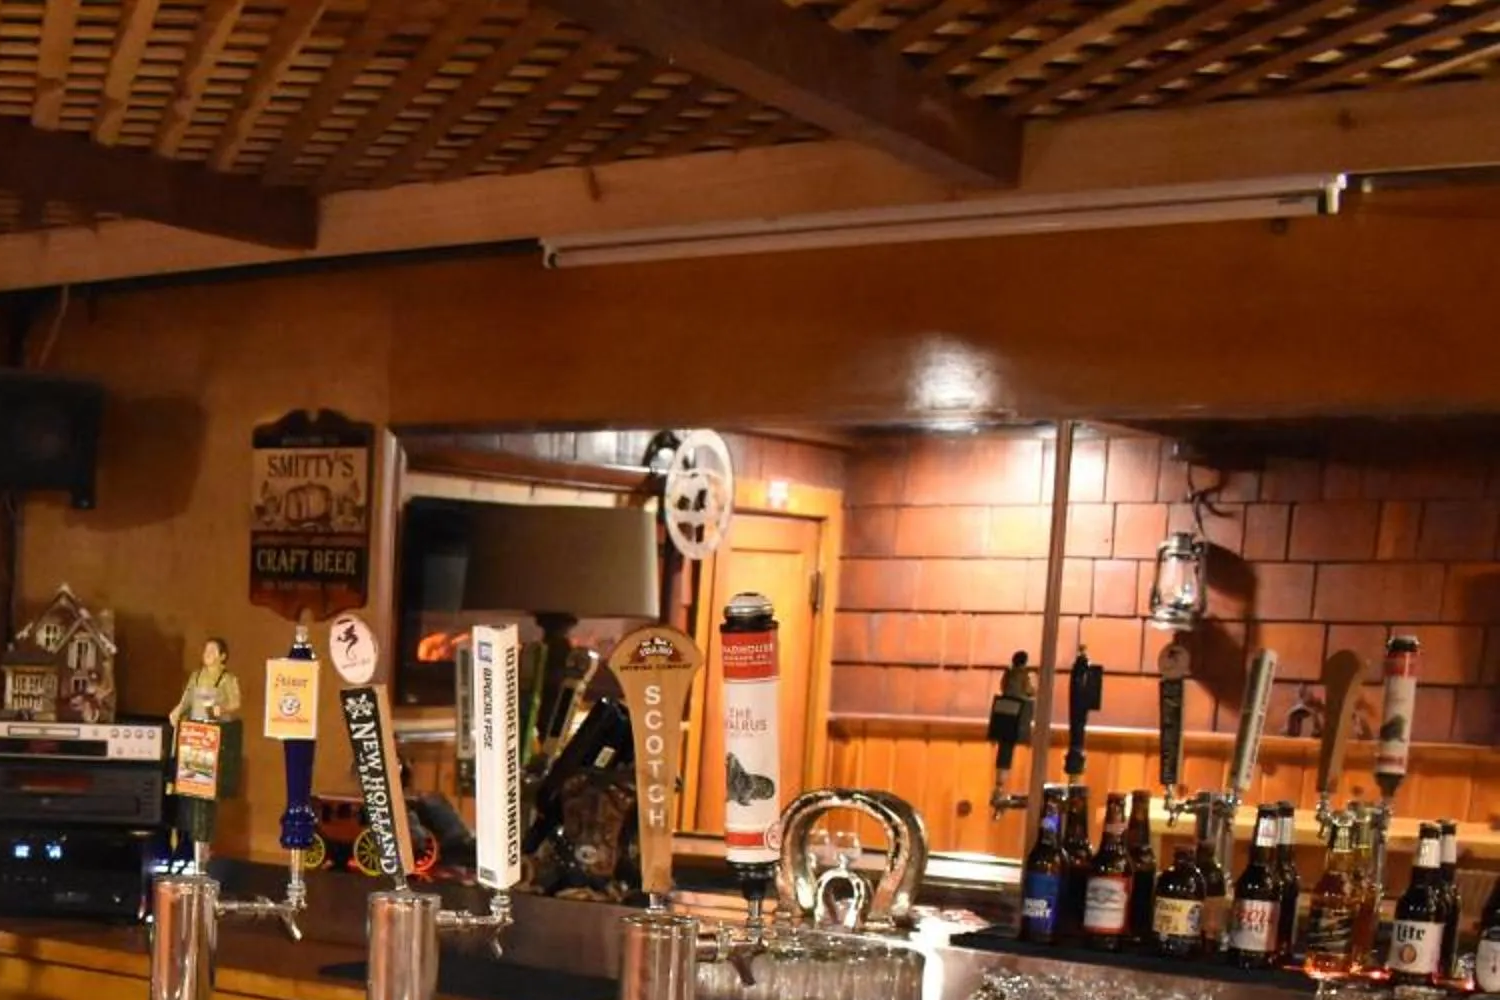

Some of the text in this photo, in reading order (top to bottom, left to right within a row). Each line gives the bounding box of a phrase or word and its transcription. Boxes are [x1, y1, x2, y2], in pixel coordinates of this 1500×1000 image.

[267, 453, 354, 478] SMITTY'S
[256, 549, 356, 574] CRAFT BEER
[644, 684, 664, 828] SCOTCH
[350, 722, 399, 874] NEW HOLLAND
[1396, 923, 1426, 942] Lite
